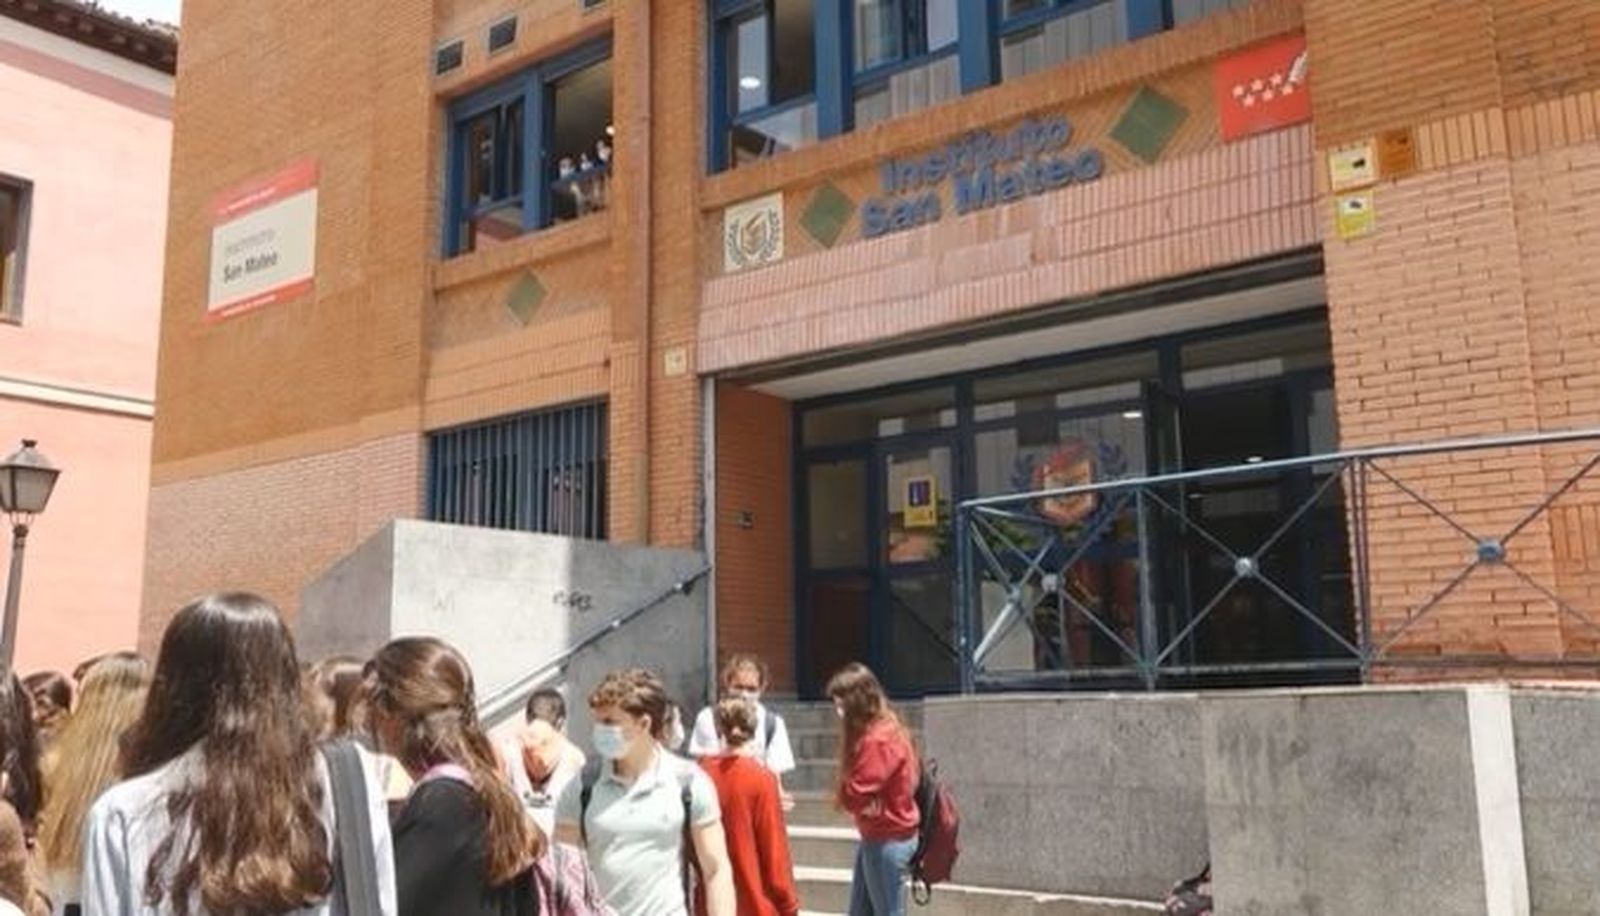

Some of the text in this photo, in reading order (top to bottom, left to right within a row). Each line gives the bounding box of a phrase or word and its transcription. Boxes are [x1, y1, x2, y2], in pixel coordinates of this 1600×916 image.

[861, 146, 1105, 238] San Mateo
[880, 114, 1072, 194] Instituto
